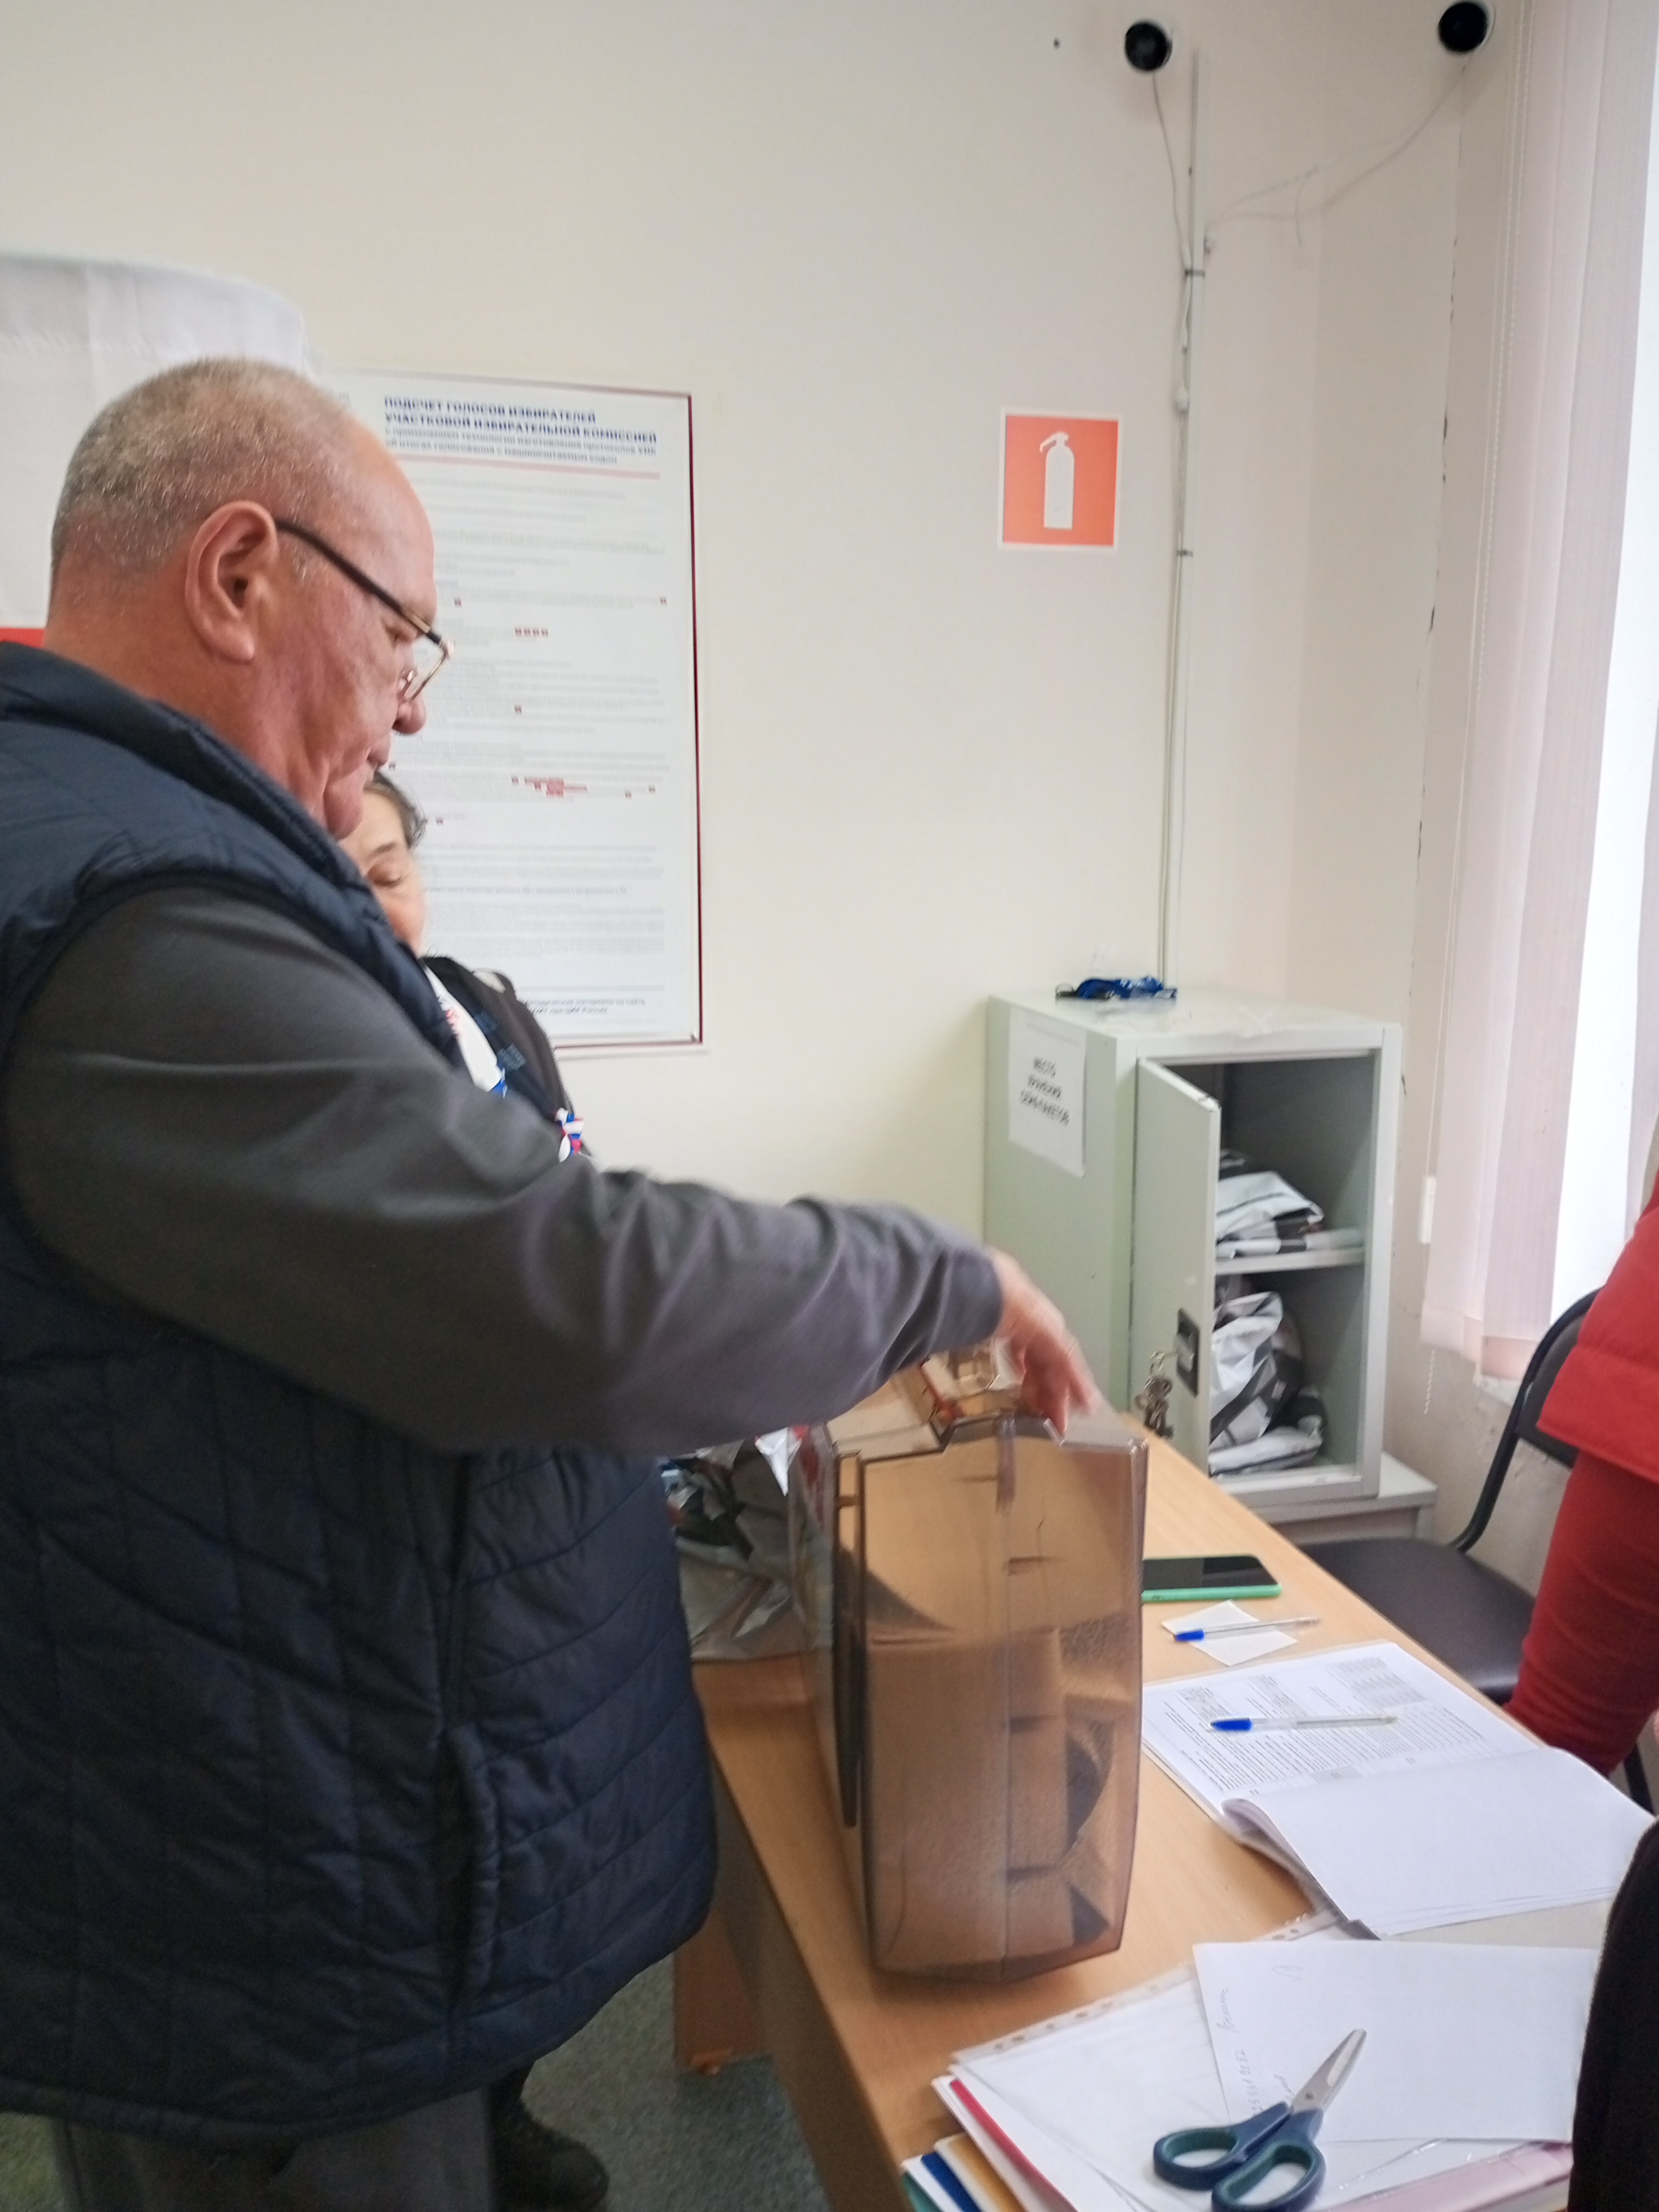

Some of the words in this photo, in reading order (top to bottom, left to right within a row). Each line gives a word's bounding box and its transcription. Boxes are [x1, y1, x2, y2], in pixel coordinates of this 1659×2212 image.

[384, 396, 443, 412] ПОДСЧЕТ
[447, 400, 505, 415] ГОЛОСОВ
[509, 404, 595, 424] ИЗБИРАТЕЛЕЙ
[385, 411, 470, 429] УЧАСТКОВОЙ
[474, 419, 580, 438] ИЗБИРАТЕЛЬНОЙ
[583, 426, 657, 444] КОМИССИЕЙ
